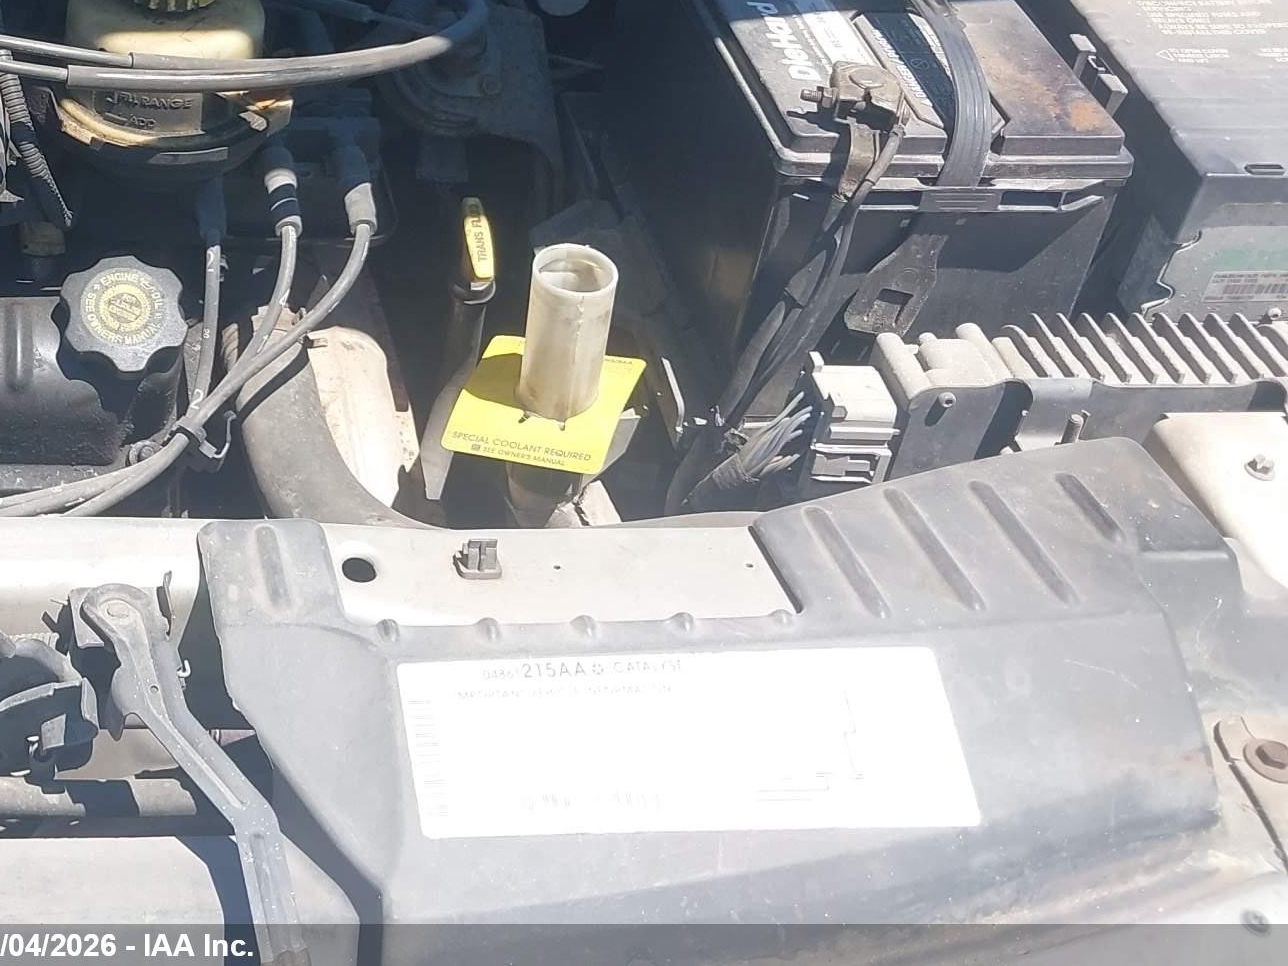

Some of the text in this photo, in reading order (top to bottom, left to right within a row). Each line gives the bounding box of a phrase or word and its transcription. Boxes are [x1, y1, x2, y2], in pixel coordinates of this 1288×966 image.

[747, 1, 822, 81] DieHard
[142, 96, 194, 109] RANGE
[473, 231, 488, 263] TRANS
[99, 271, 140, 286] ENGINE
[190, 388, 204, 410] 2
[452, 431, 591, 461] SPECIAL COOLANT REQUIRED
